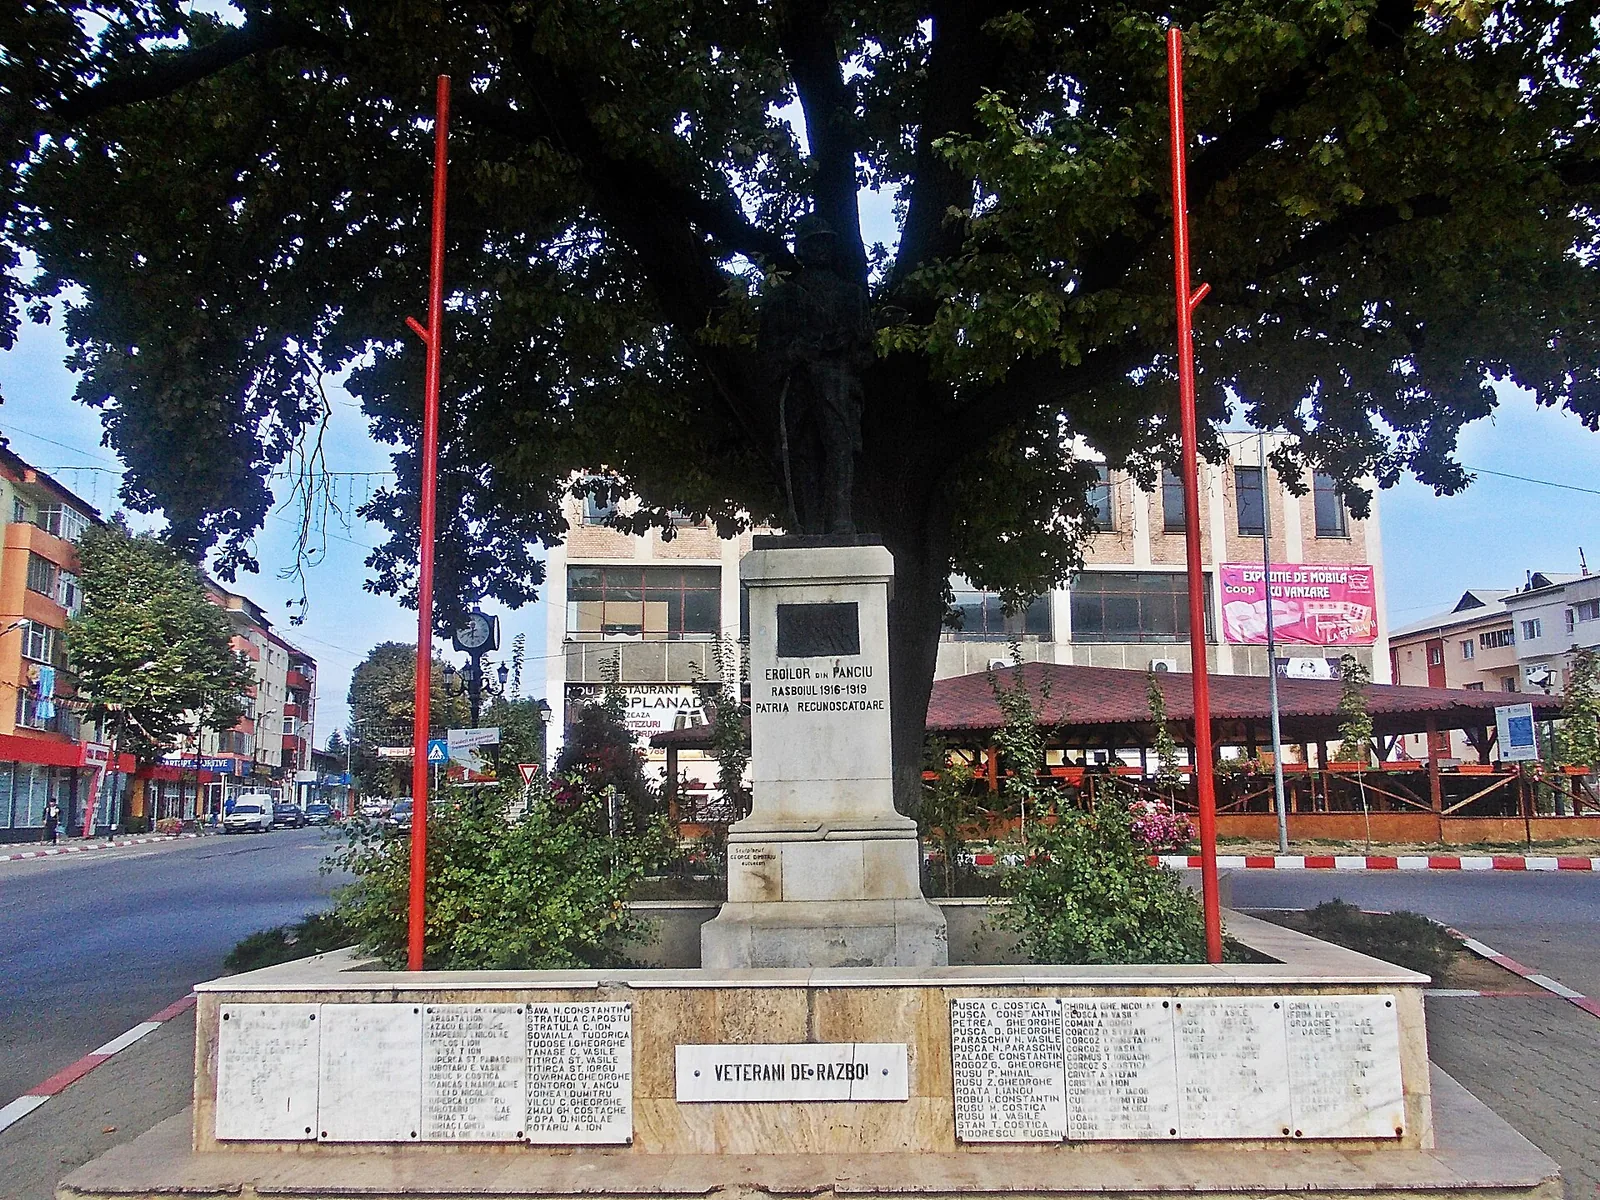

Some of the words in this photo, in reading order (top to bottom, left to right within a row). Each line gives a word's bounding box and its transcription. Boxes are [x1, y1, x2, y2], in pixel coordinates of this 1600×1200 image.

[1293, 572, 1307, 582] DE
[1310, 572, 1348, 583] MOBILA
[1226, 586, 1255, 595] coop
[1271, 586, 1282, 597] CU
[1284, 586, 1330, 598] VANZARE
[1328, 634, 1338, 643] LA
[766, 668, 810, 680] EROILOR
[833, 666, 873, 678] PANCIU
[772, 686, 818, 696] RASBOIUL
[820, 684, 867, 695] 1916-1919
[756, 703, 789, 712] PATRIA
[798, 700, 884, 712] RECUNOSCATOARE
[997, 1010, 1060, 1018] CONSTANTIN
[715, 1064, 785, 1081] VETERANI
[791, 1064, 810, 1081] DE
[816, 1063, 869, 1080] RAZBOI
